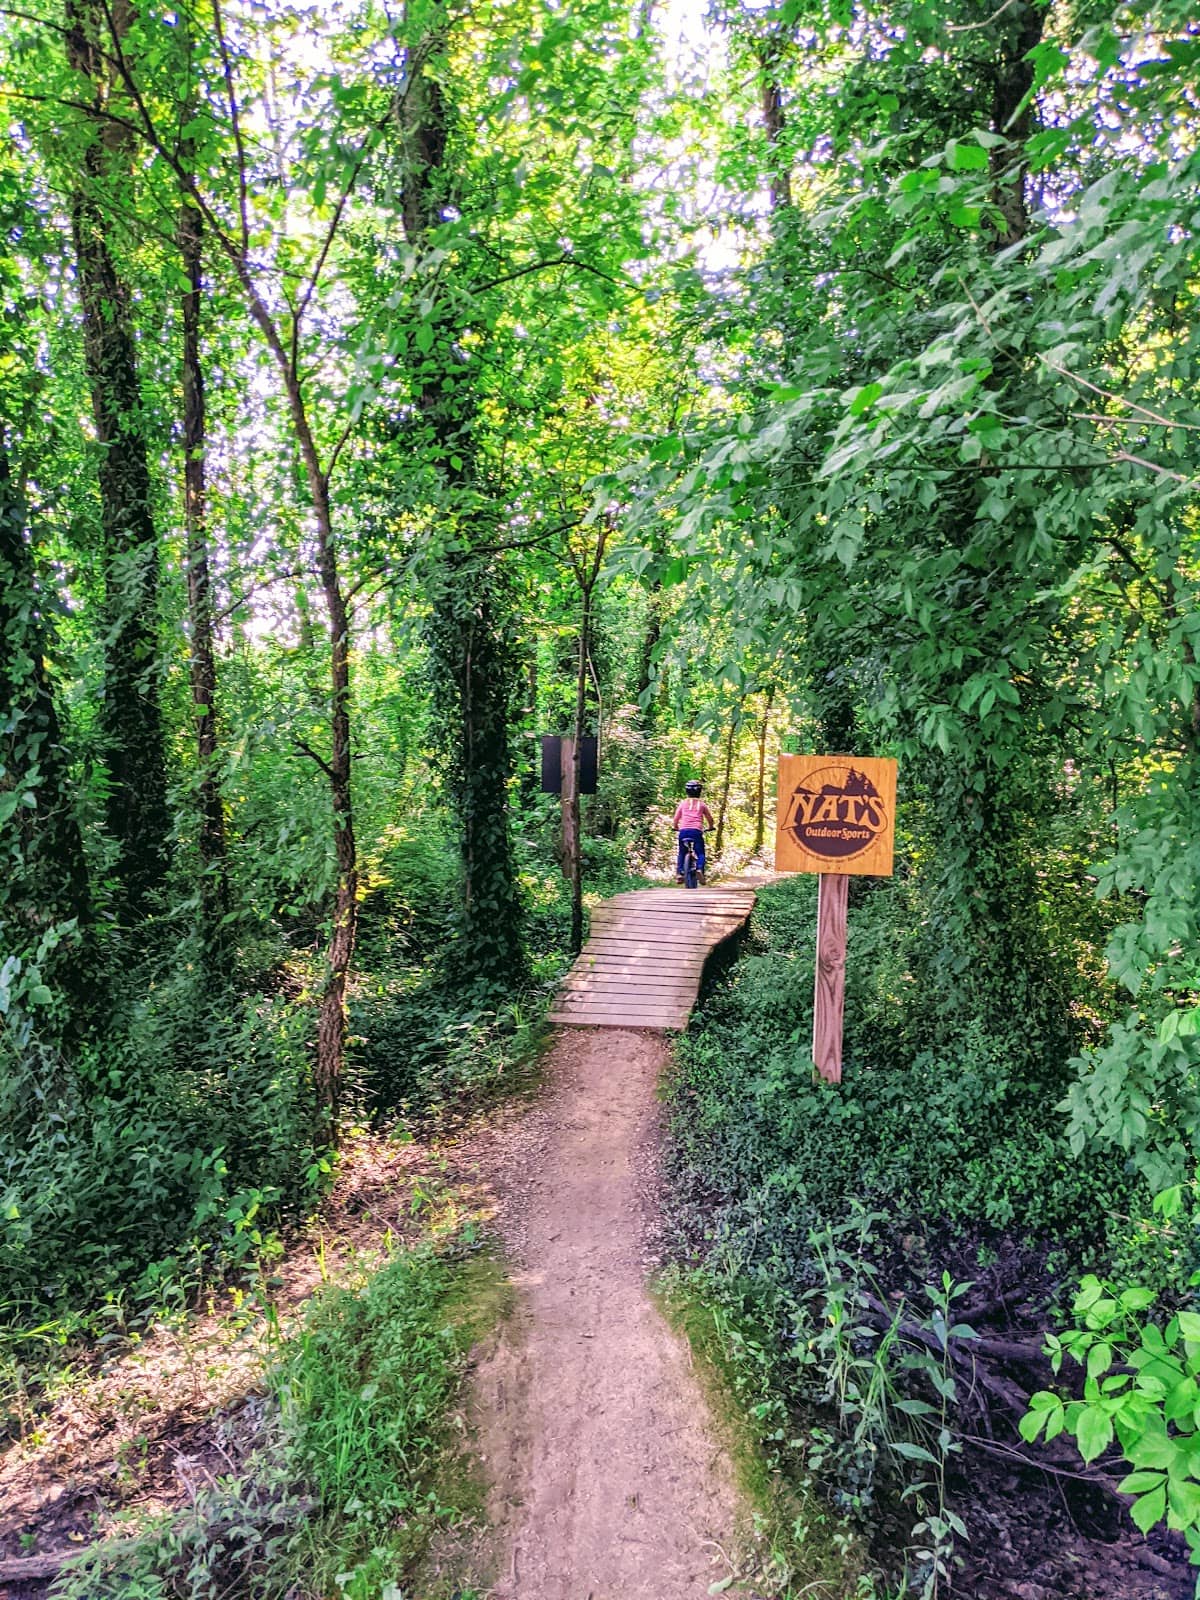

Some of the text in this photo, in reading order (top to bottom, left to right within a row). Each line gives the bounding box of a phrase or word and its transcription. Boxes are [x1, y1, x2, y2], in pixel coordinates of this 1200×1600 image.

[781, 793, 888, 833] NAT'S
[805, 827, 870, 840] Outdoor Sports
